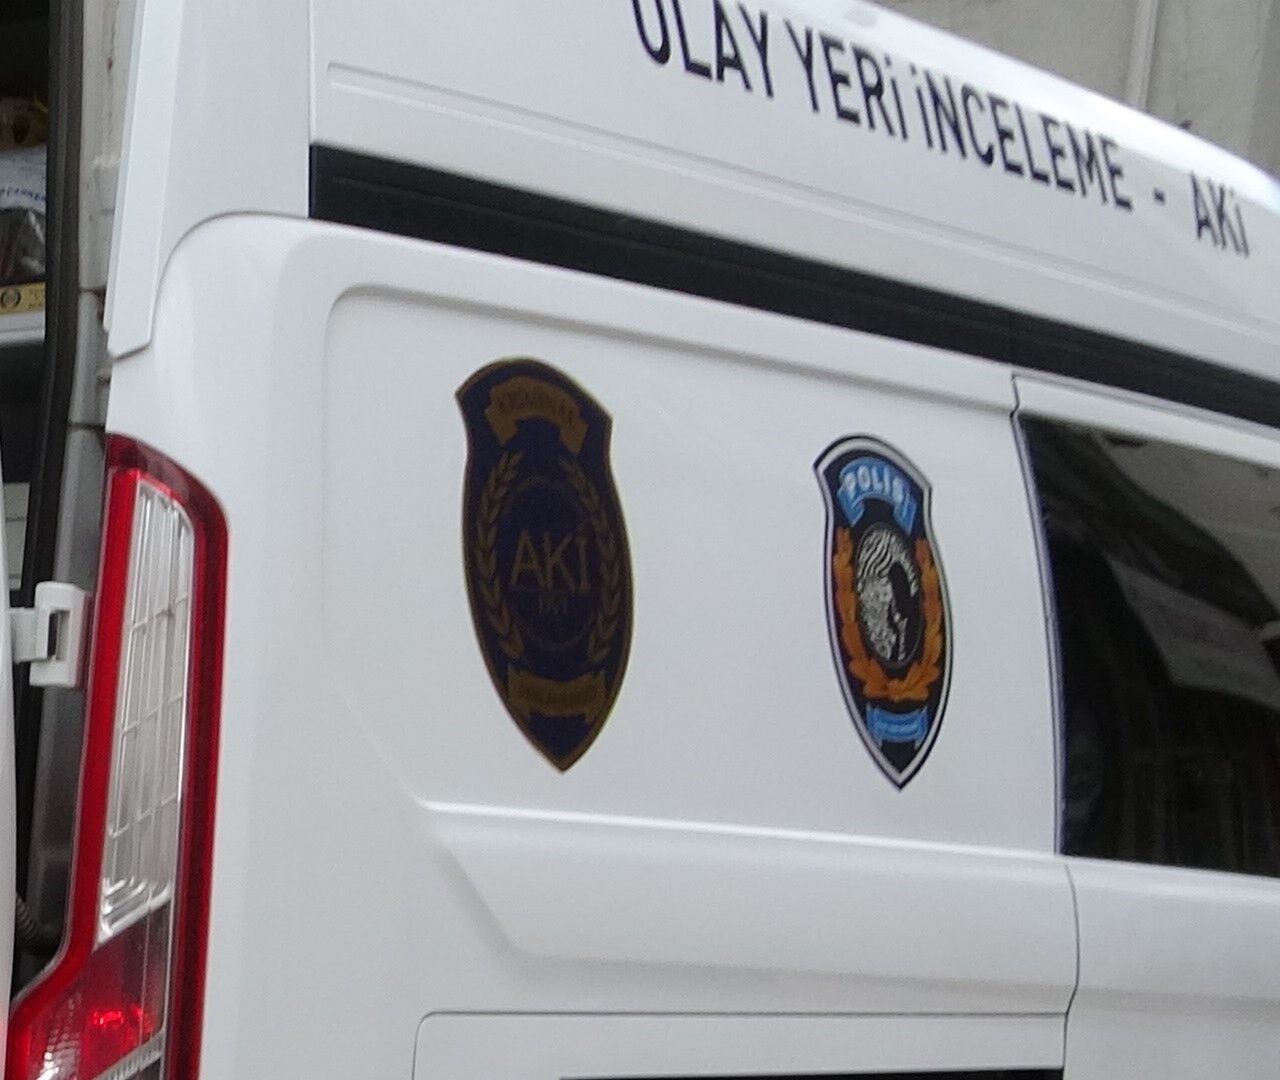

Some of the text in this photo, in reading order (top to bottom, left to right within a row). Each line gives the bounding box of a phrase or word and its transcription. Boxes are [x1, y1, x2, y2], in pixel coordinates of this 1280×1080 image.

[631, 0, 774, 99] OLAY
[783, 18, 908, 142] YERİ
[909, 63, 1134, 212] İNCELEME
